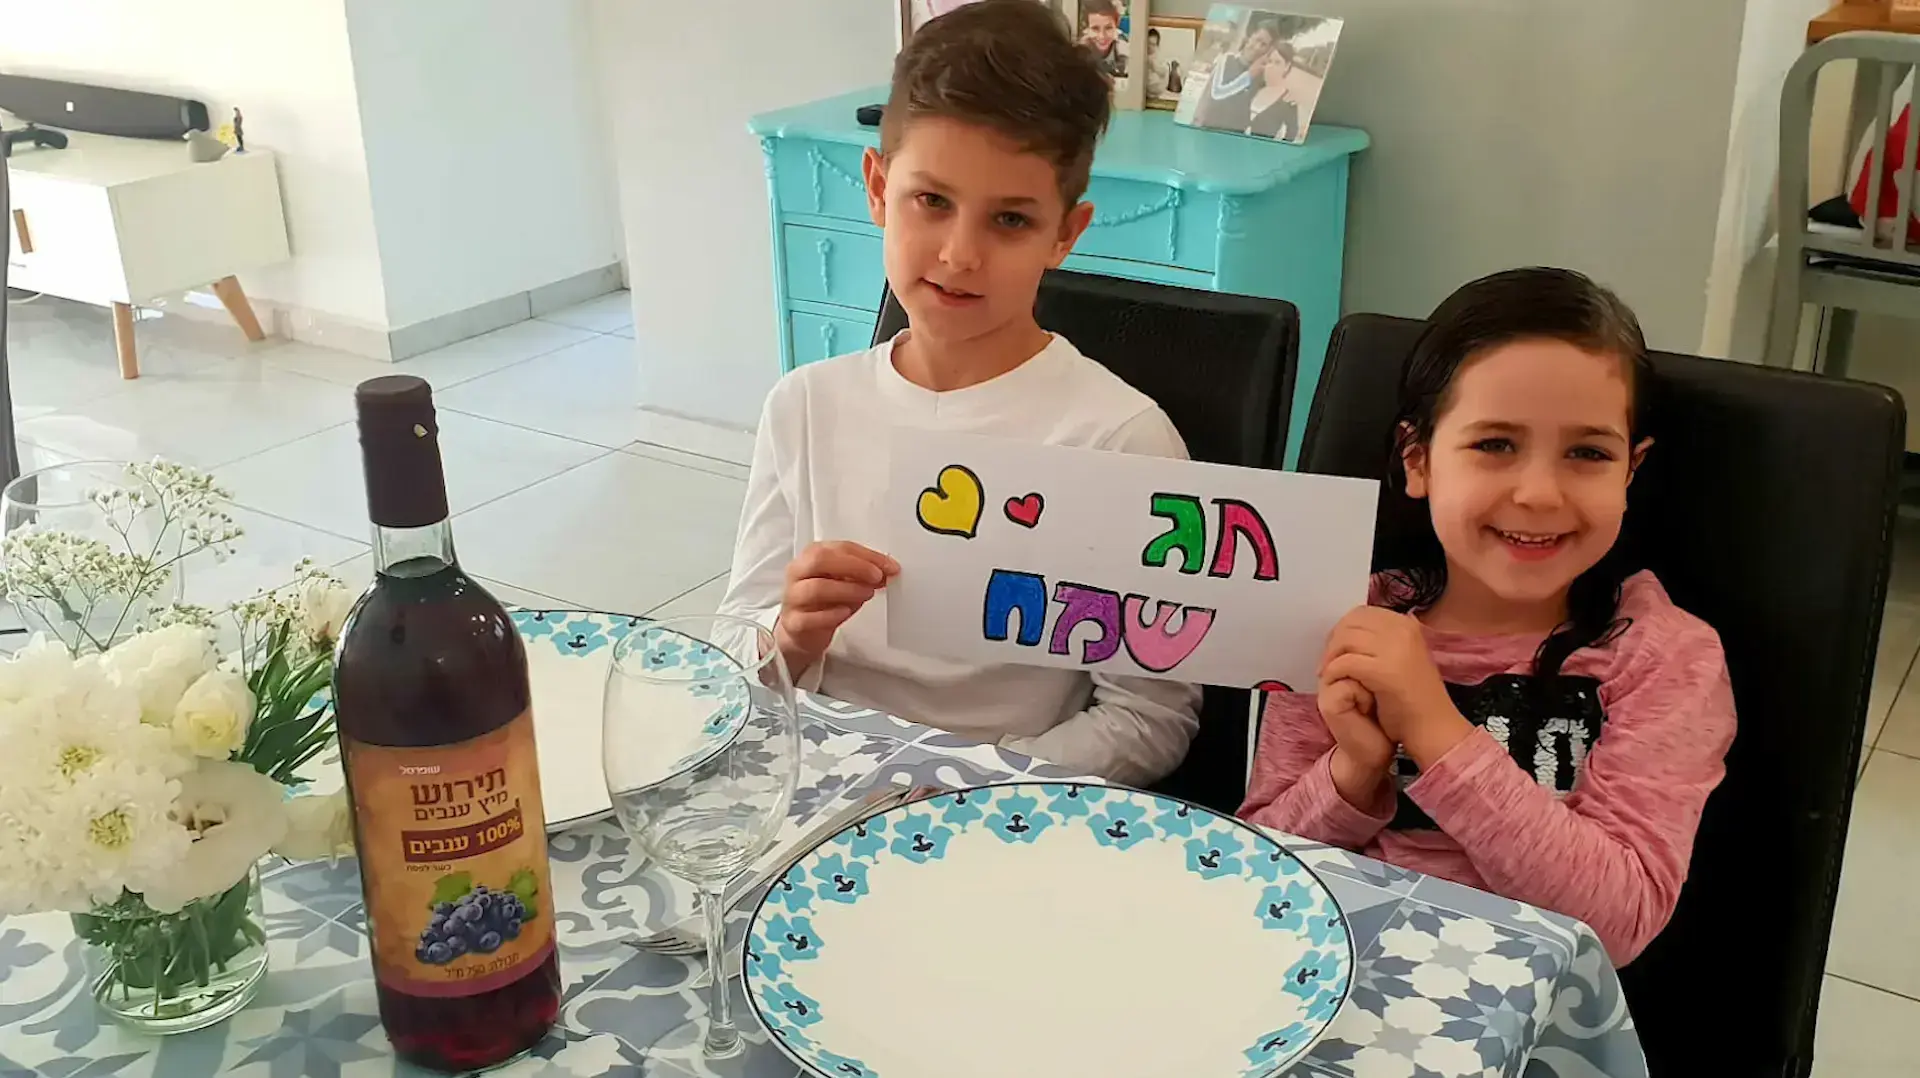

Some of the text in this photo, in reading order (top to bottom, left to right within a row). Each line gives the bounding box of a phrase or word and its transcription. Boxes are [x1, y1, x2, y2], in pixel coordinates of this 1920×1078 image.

[1142, 492, 1280, 581] חג
[983, 568, 1216, 672] שמח
[399, 765, 441, 775] שופרסל
[410, 767, 507, 806] תירוש
[414, 790, 508, 821] מיץ ענבים
[409, 815, 521, 854] 100% ענבים
